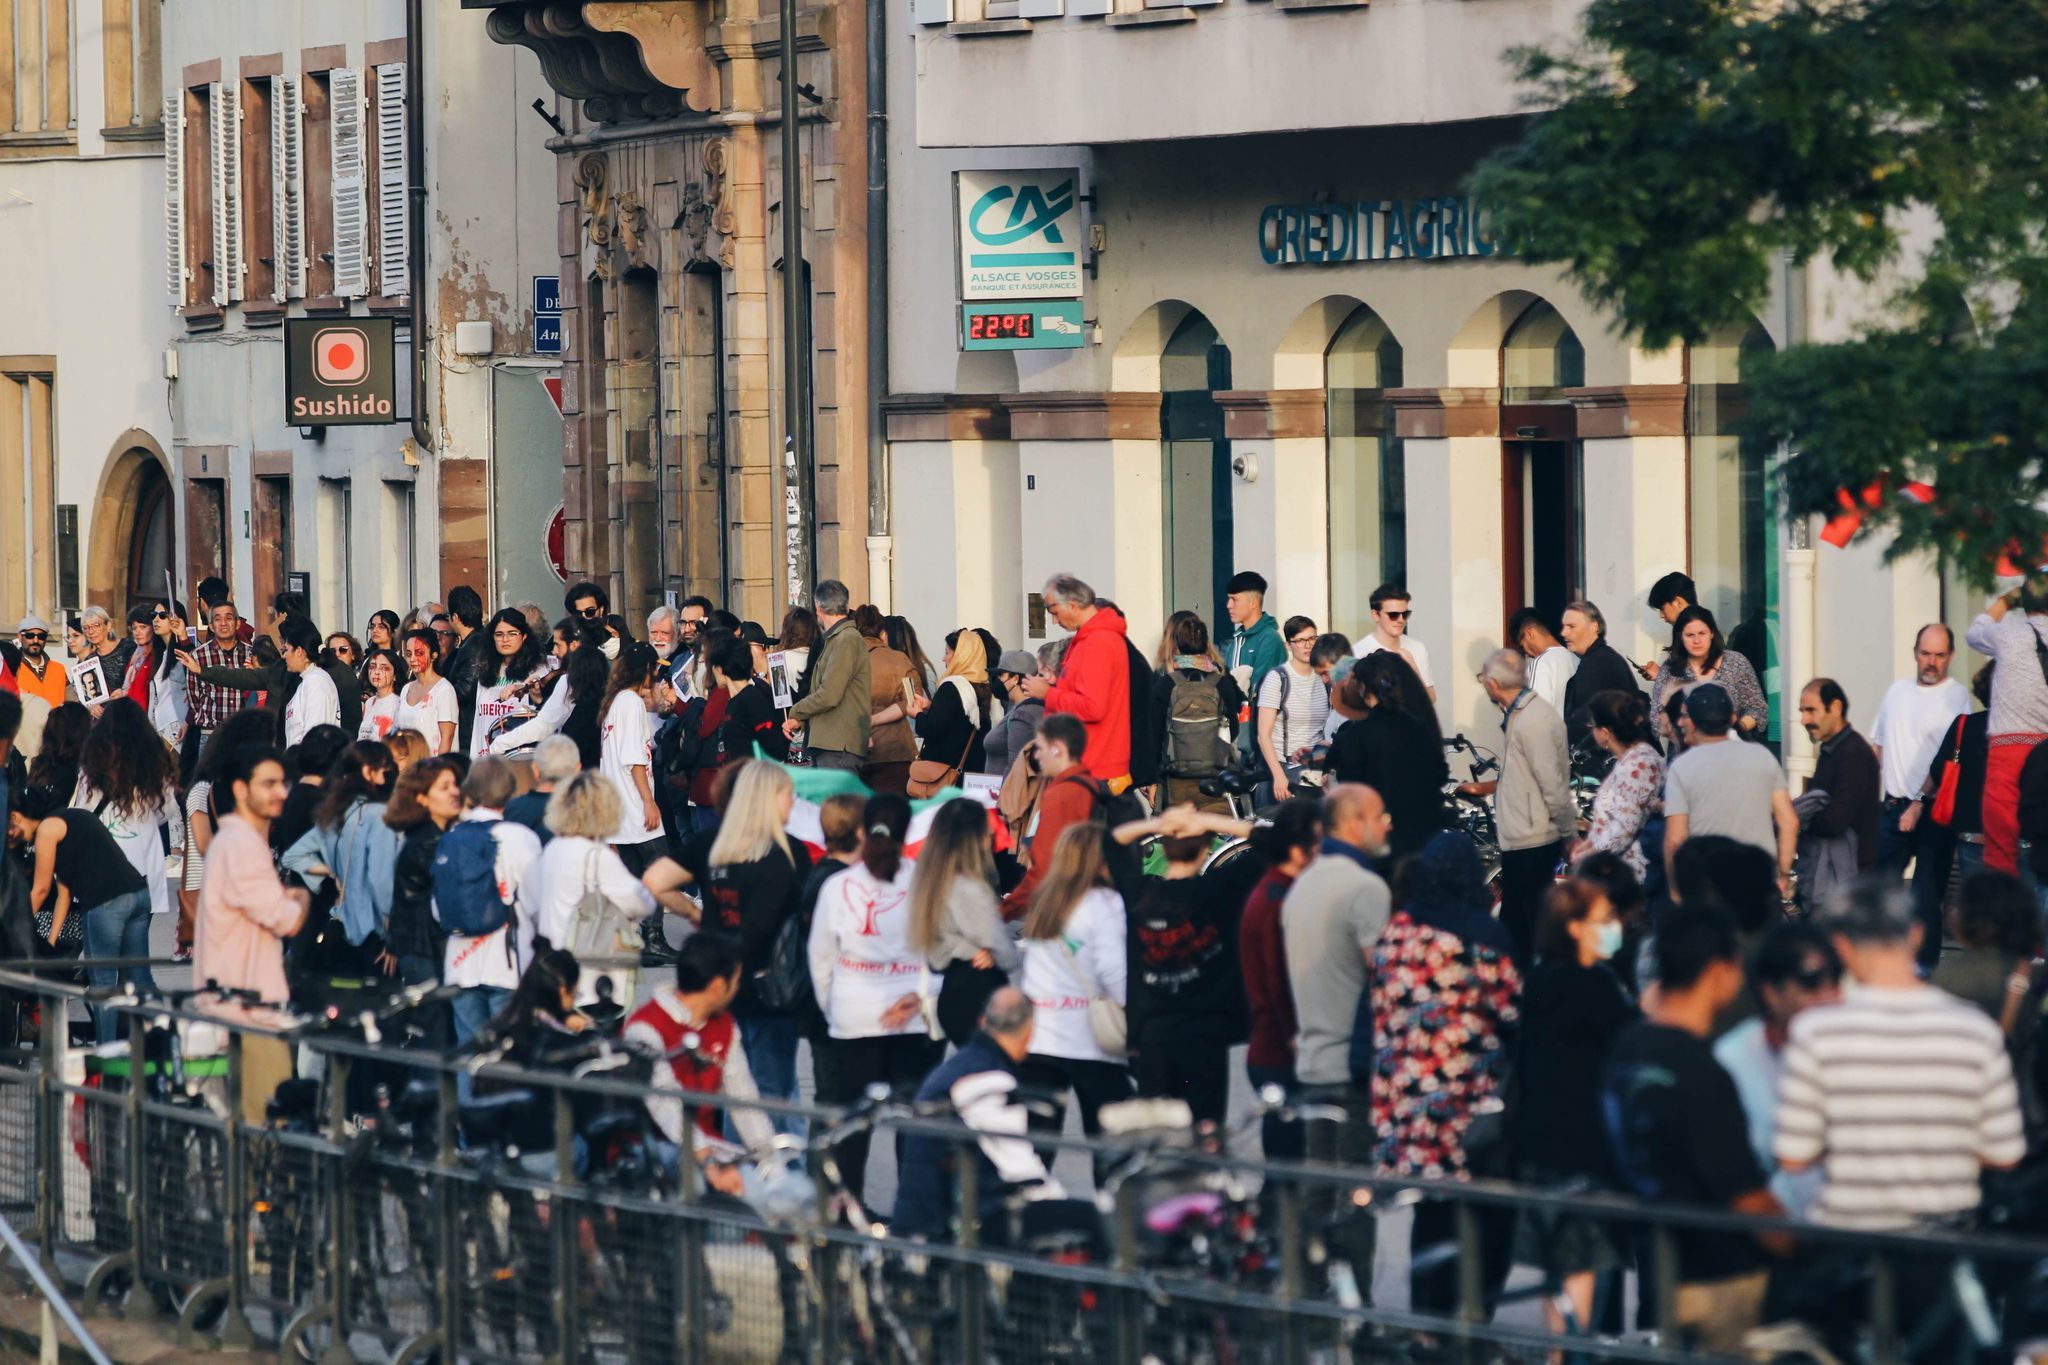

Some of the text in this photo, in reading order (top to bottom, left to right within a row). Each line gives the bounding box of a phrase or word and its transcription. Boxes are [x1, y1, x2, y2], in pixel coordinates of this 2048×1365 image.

[1384, 194, 1499, 260] AGRIC
[971, 271, 1077, 282] ALSACE VOSGES
[971, 284, 1006, 292] BANQUE
[1021, 283, 1077, 291] ASSURANCES
[539, 328, 561, 340] An
[293, 393, 392, 417] Sushido
